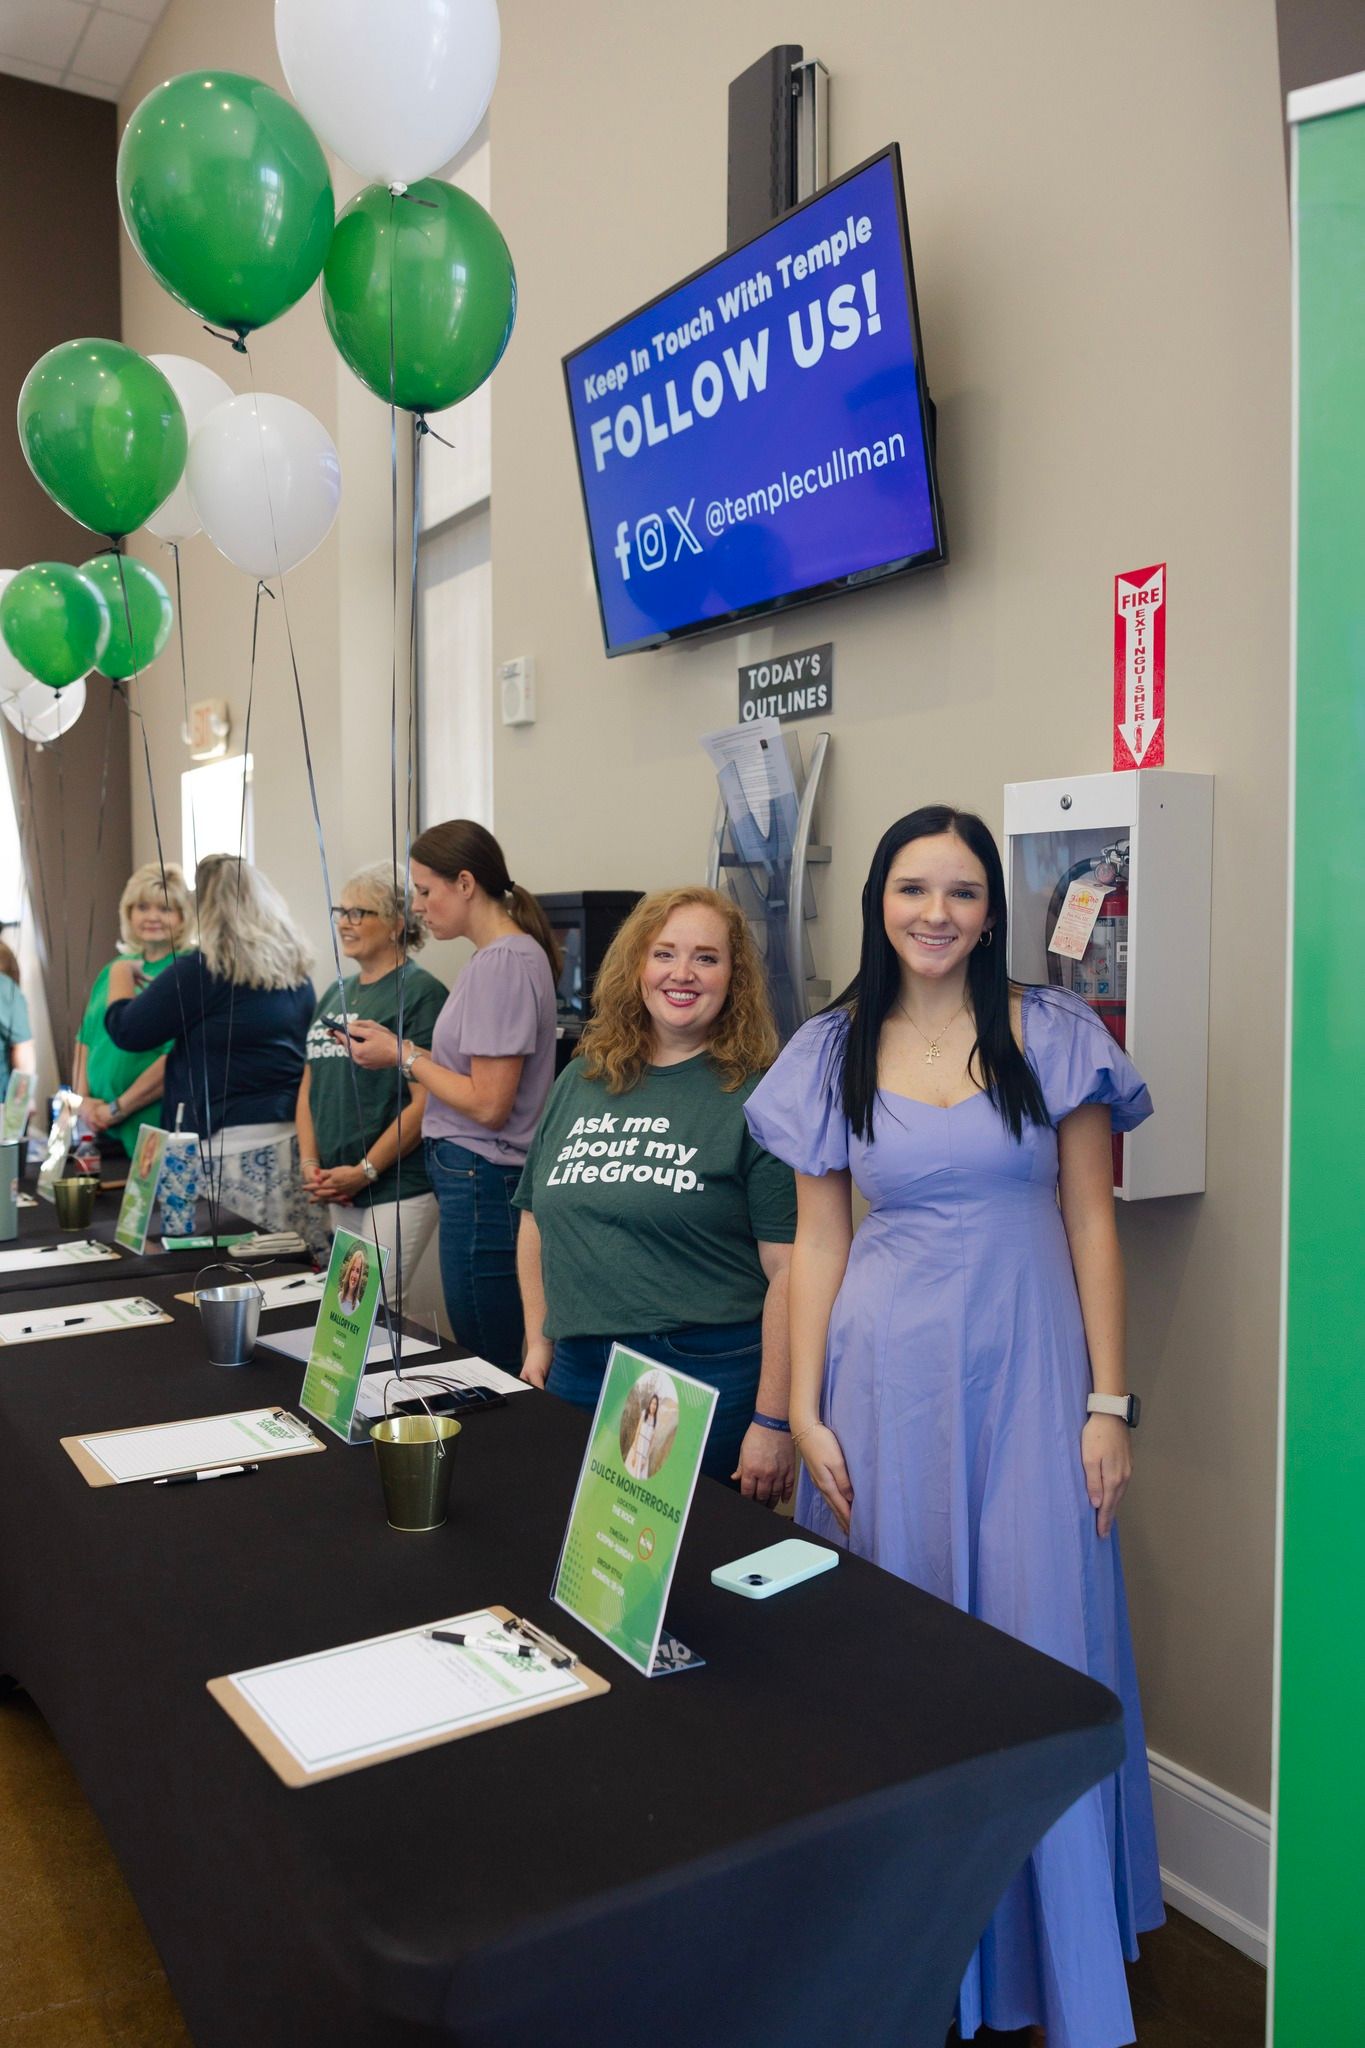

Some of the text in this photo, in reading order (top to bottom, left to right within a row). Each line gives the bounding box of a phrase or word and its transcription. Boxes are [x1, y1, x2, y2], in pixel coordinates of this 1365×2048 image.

[584, 215, 872, 402] Keep In Touch With Temple
[590, 269, 882, 472] FOLLOW US!
[706, 433, 905, 536] @templecullman
[1122, 587, 1160, 609] FIRE
[748, 654, 821, 690] TODAY'S
[1134, 608, 1146, 721] EXTINGUISHER
[743, 684, 827, 721] OUTLINES
[566, 1113, 670, 1139] Ask me
[557, 1137, 698, 1166] about my
[547, 1160, 705, 1193] LifeGroup.
[590, 1459, 681, 1524] DULCE MONTERROSAS
